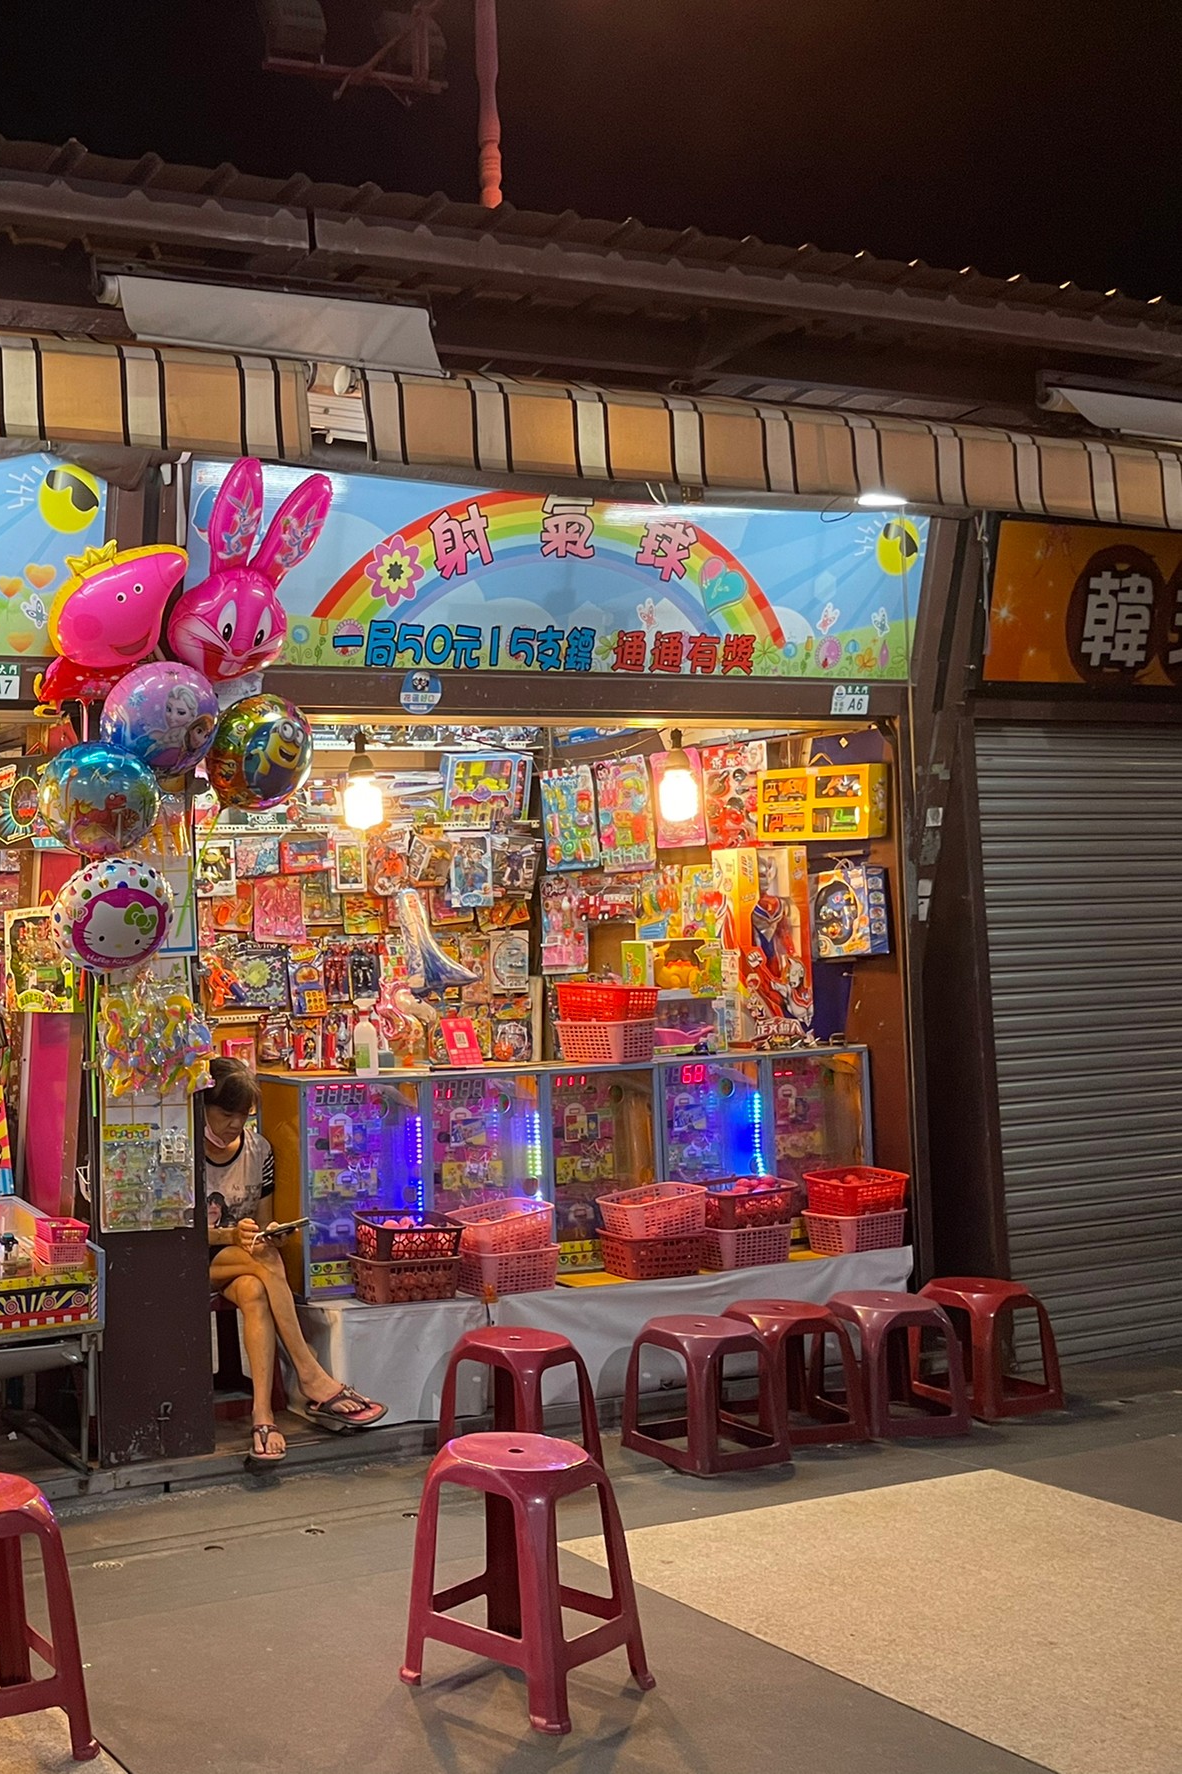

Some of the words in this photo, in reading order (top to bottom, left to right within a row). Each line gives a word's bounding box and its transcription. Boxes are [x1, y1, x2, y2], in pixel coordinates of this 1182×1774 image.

[431, 494, 698, 582] 射氣球
[332, 619, 598, 672] 一局50元15支鏢
[611, 629, 758, 676] 通通有獎
[1081, 570, 1182, 669] 韓
[847, 698, 864, 711] A6
